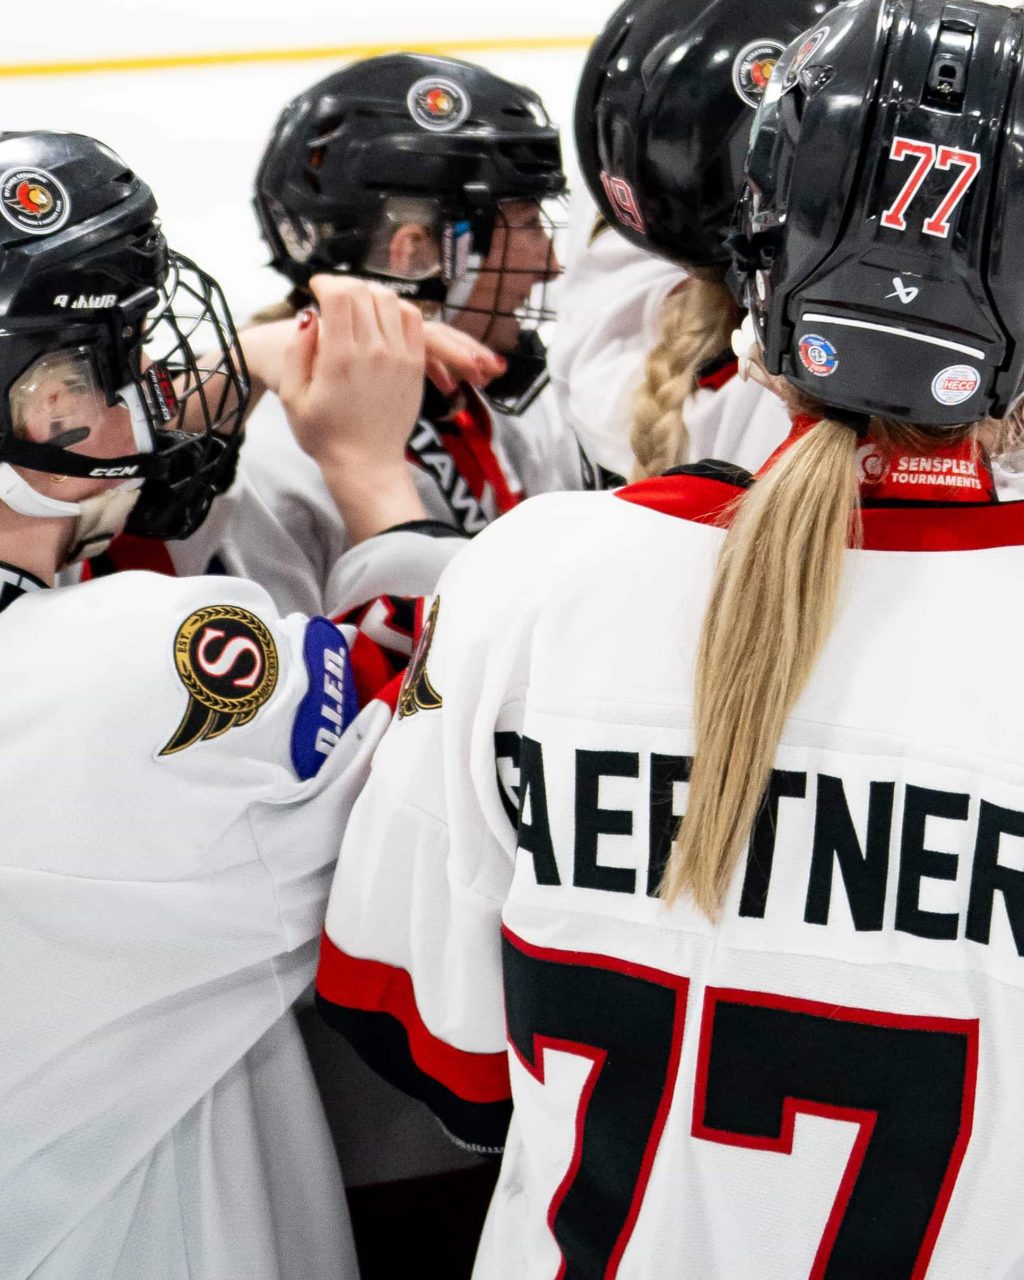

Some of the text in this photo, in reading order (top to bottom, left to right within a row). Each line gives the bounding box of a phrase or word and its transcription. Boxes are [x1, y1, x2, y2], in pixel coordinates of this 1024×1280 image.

[879, 136, 982, 239] 77
[88, 465, 140, 477] CCM
[891, 472, 982, 490] TOURNAMENTS
[897, 456, 977, 476] SENSPLEX
[196, 627, 264, 688] S
[500, 923, 981, 1280] 77
